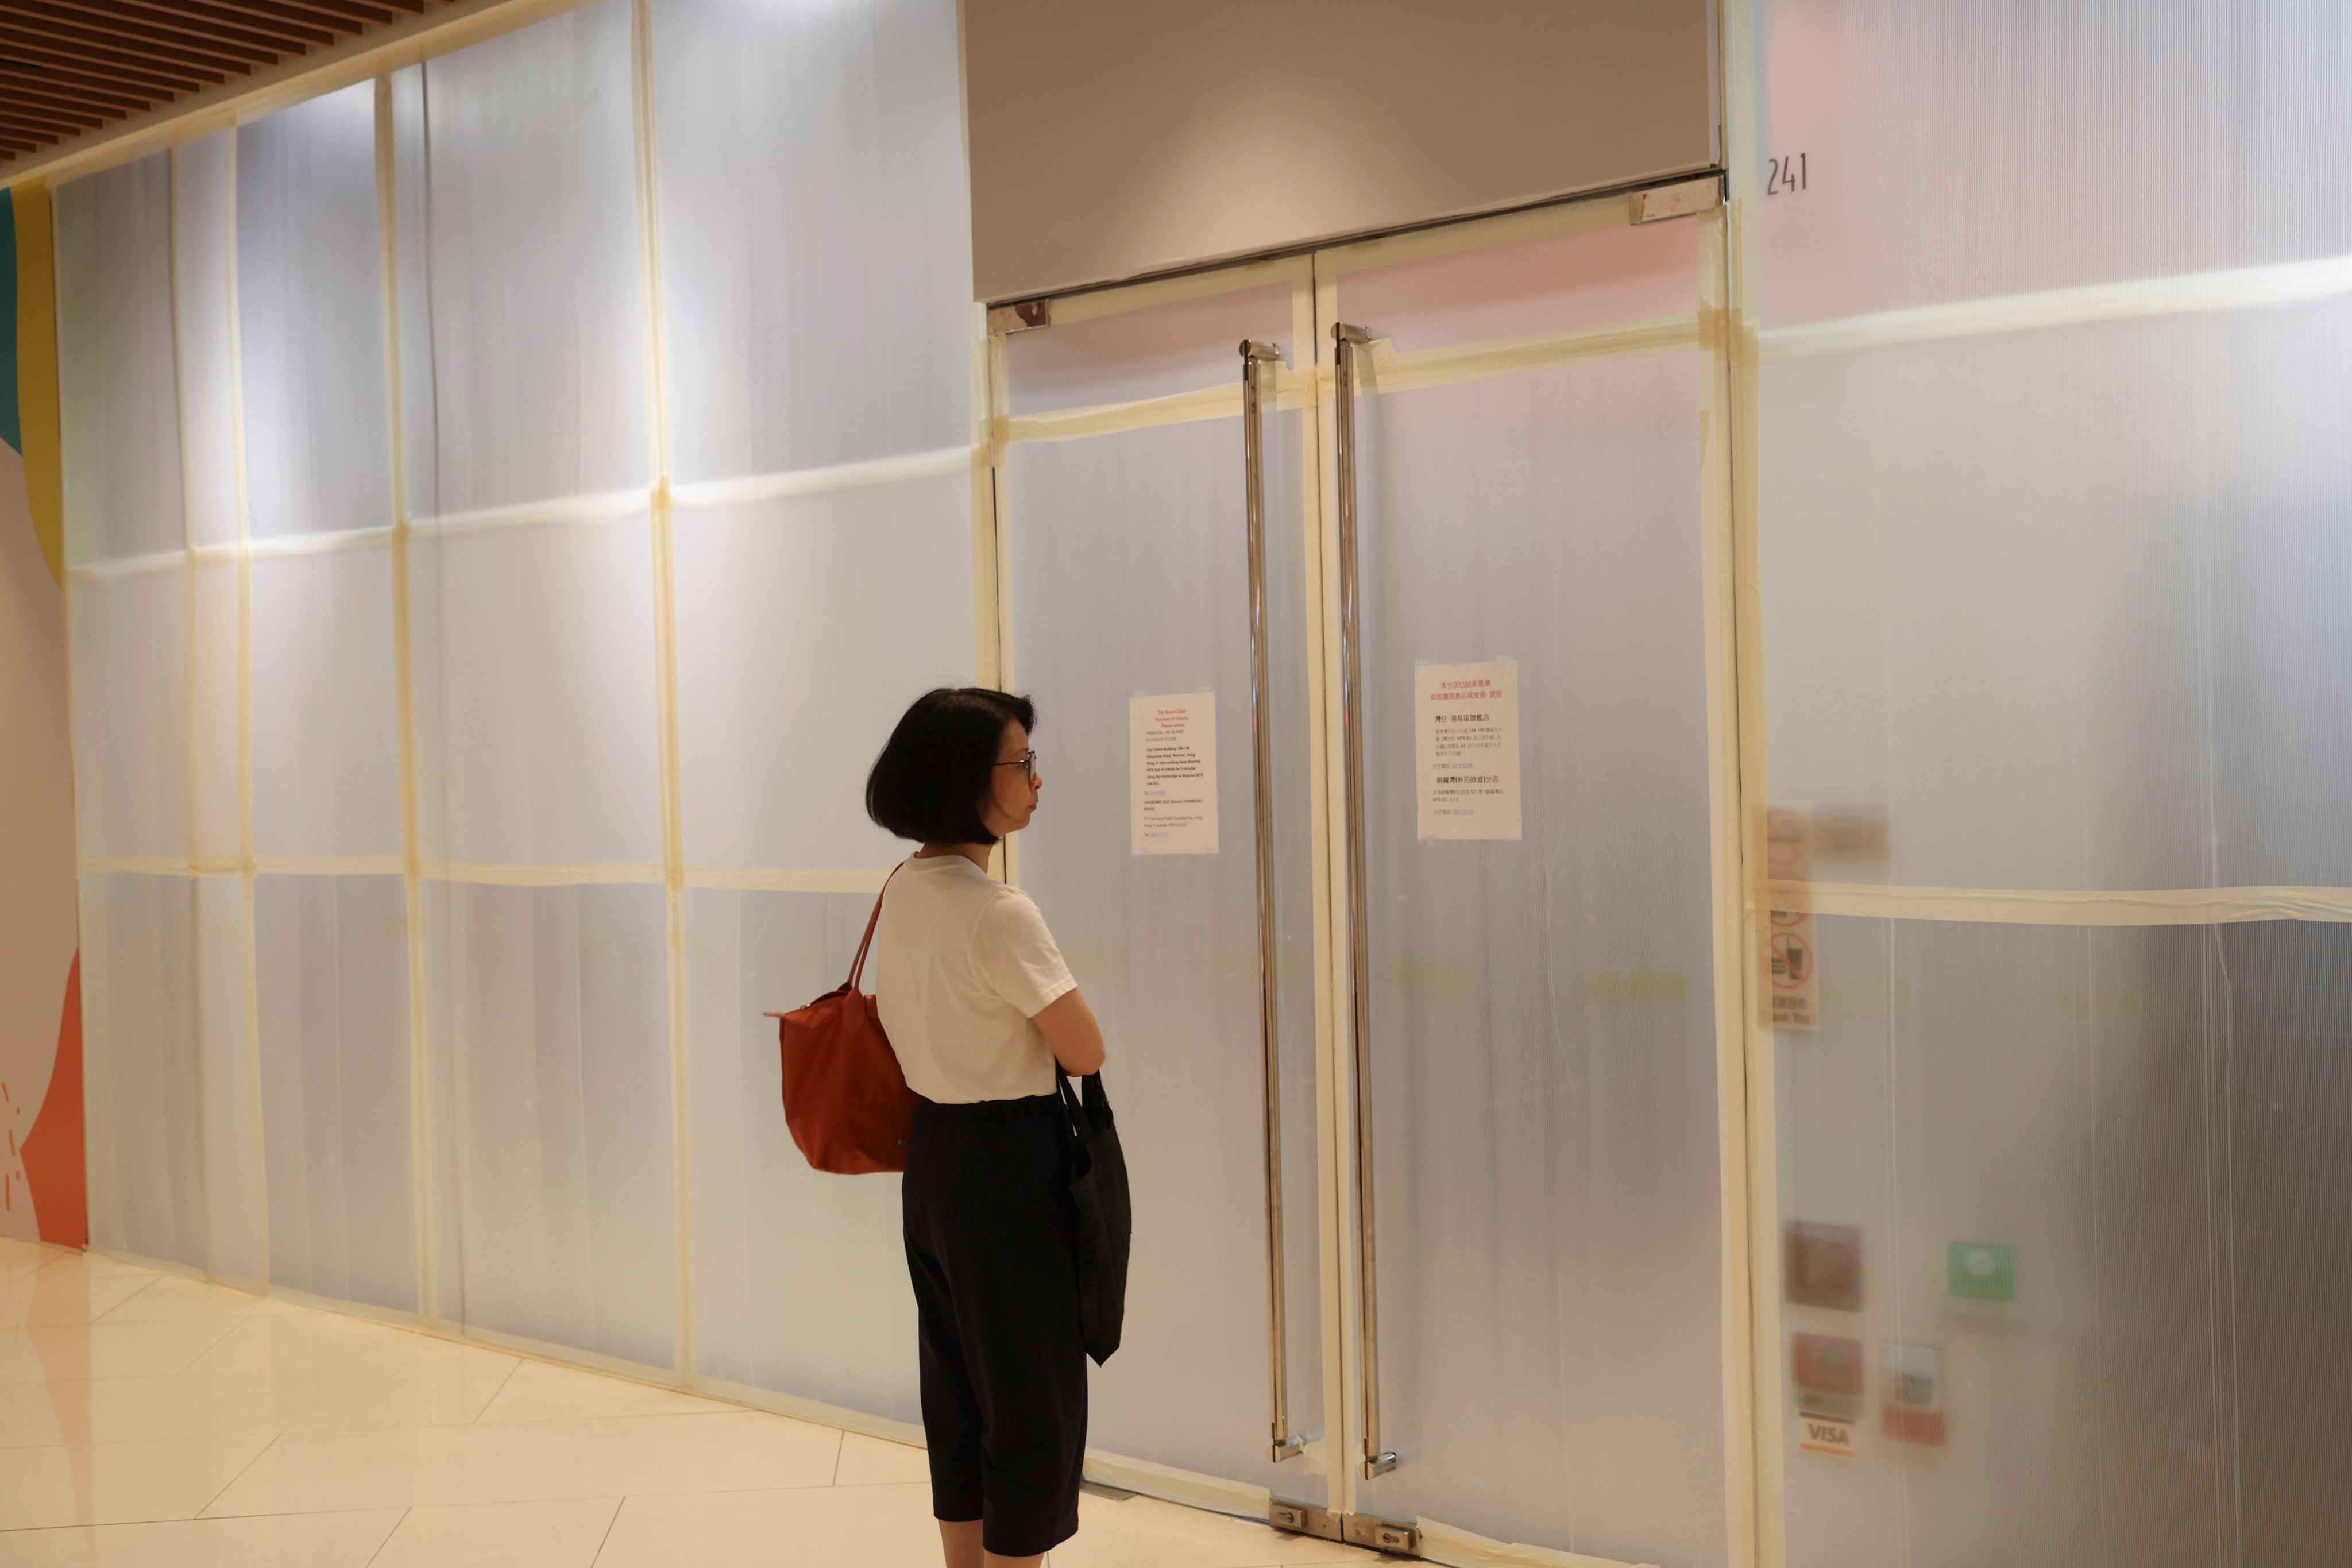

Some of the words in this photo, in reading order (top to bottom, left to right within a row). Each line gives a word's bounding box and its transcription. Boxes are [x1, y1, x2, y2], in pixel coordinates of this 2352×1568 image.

[1768, 153, 1806, 195] 241
[1441, 679, 1491, 689] 本分店已結束營業
[1806, 1423, 1848, 1446] VISA
